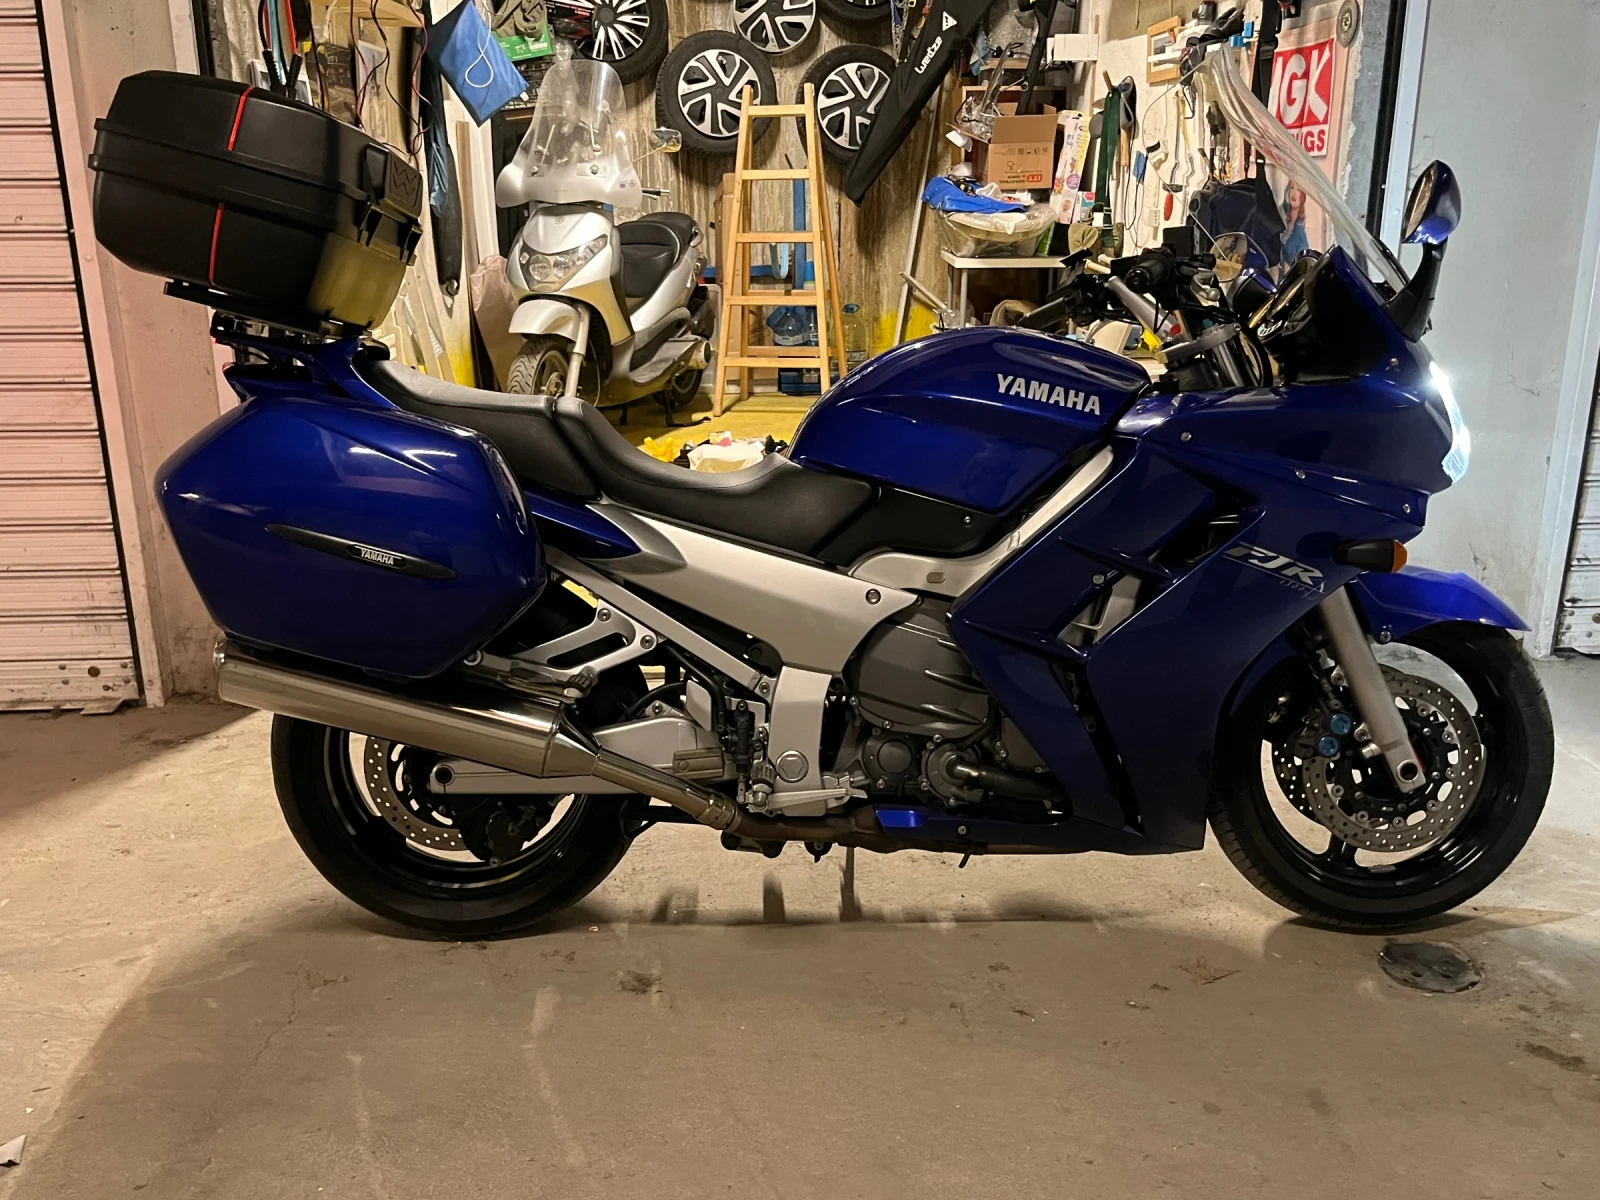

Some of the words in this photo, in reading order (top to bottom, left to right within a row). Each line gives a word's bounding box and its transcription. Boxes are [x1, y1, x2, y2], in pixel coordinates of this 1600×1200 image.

[997, 373, 1100, 416] YAMAHA
[361, 548, 394, 566] YAMAHA
[1223, 541, 1323, 586] FJR
